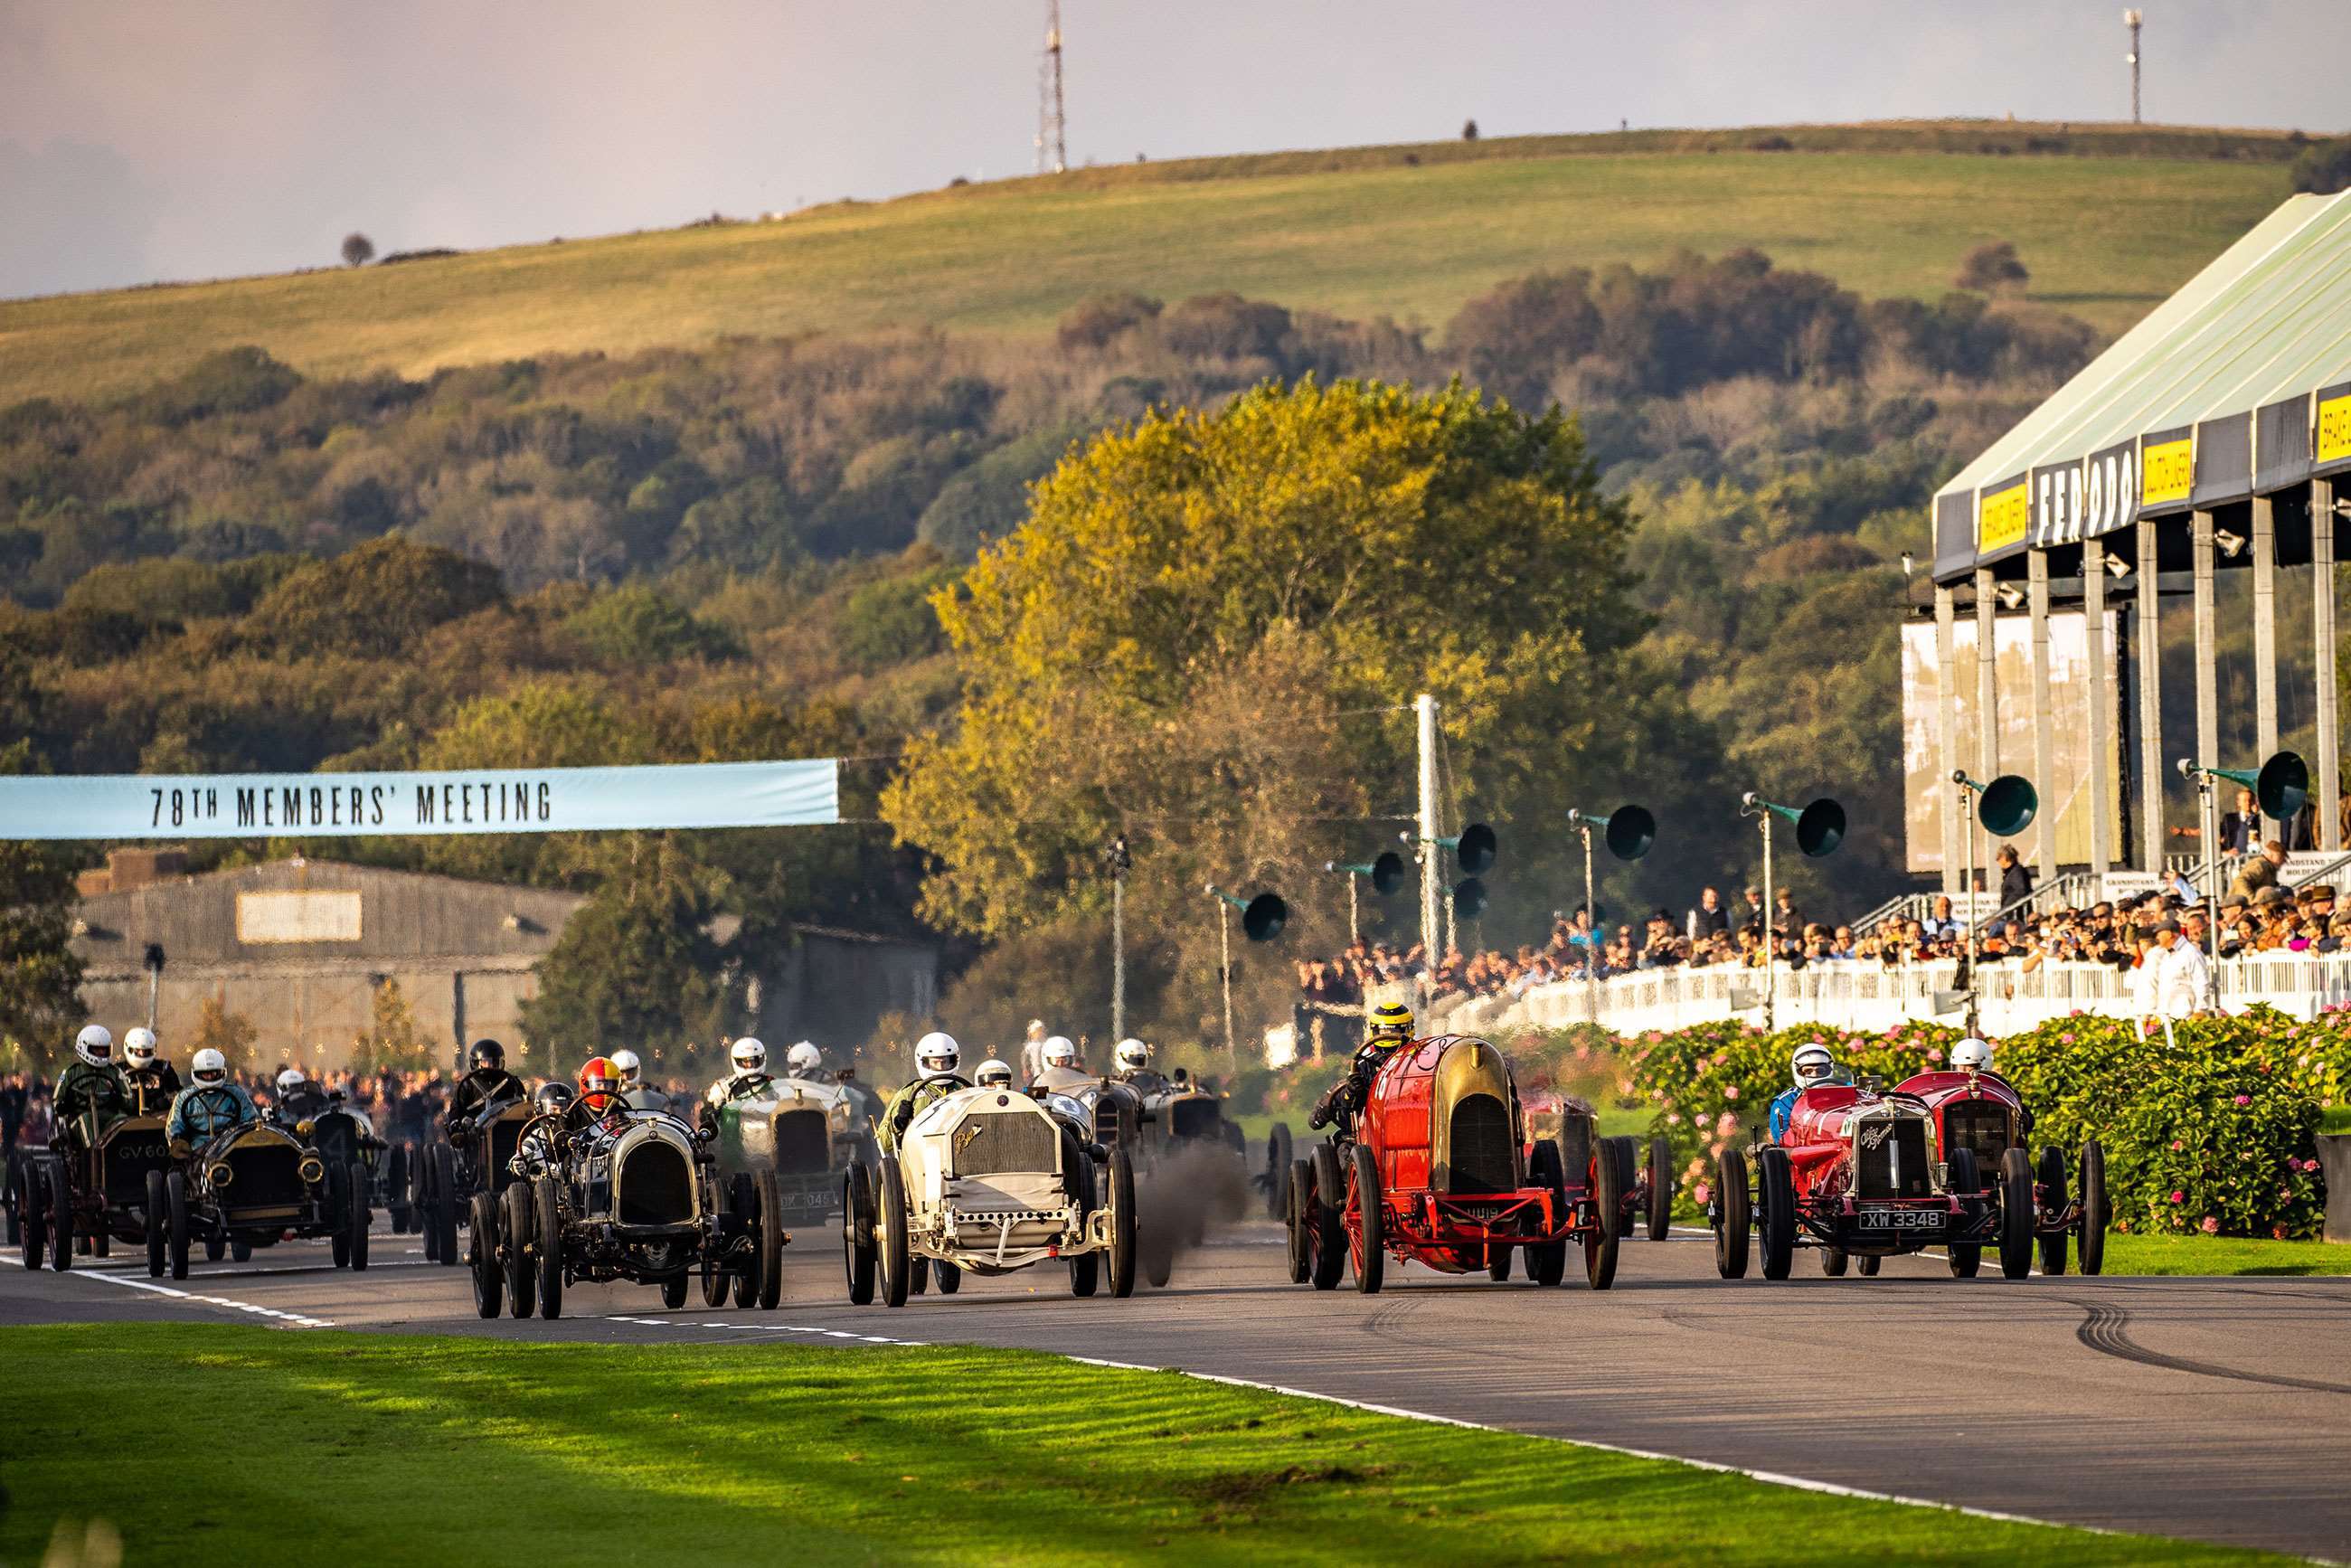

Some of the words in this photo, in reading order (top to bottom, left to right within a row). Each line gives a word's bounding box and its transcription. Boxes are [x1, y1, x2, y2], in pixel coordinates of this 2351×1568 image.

[2036, 449, 2134, 548] FERODO
[151, 787, 217, 827] 78TH
[237, 785, 395, 827] MEMBERS'
[417, 782, 550, 825] MEETING
[1867, 1213, 1890, 1227] XW
[1893, 1212, 1939, 1227] 3348
